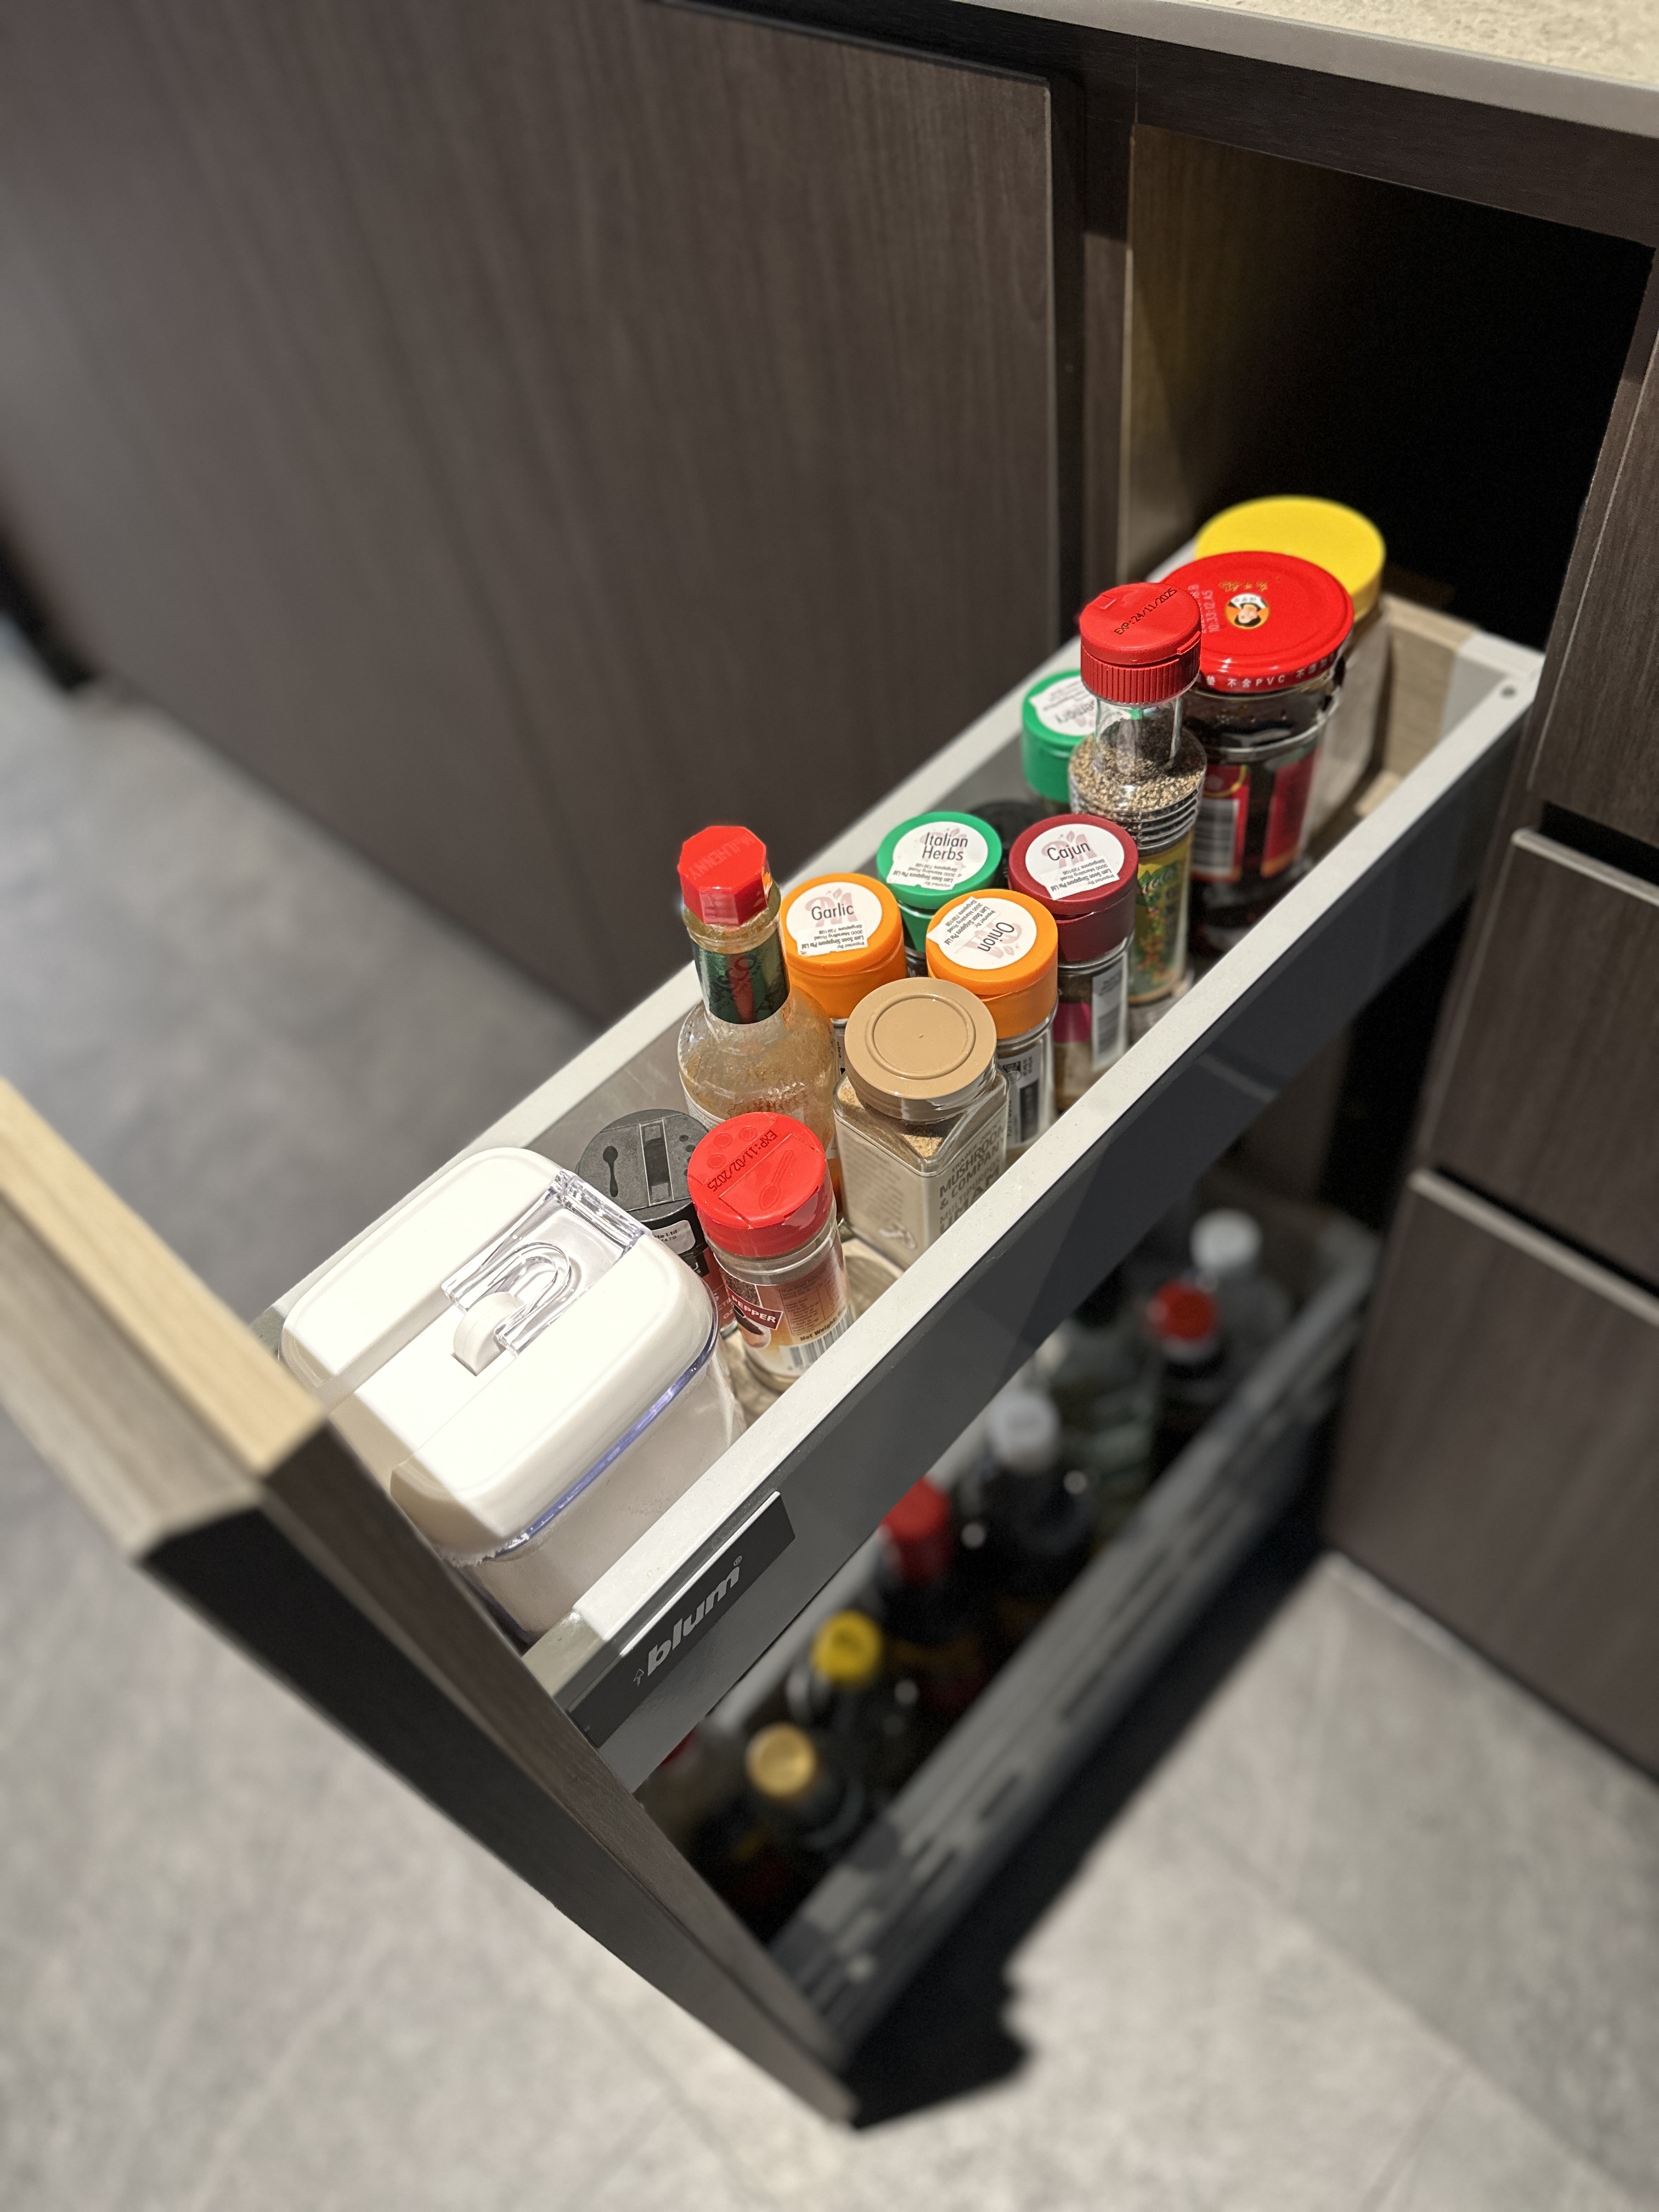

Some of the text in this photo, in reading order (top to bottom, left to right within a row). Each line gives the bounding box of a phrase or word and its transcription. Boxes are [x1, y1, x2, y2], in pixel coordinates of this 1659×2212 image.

[1113, 587, 1178, 635] EXP:24/11/2025
[924, 832, 968, 848] Italian
[922, 845, 964, 861] Herbs
[1047, 842, 1091, 861] Cajun
[1081, 859, 1105, 869] Singapore
[909, 872, 931, 881] Singapore
[1066, 876, 1088, 886] Singapore
[811, 902, 855, 921] Garlic
[818, 938, 841, 946] Singapore
[977, 922, 1014, 952] Onion
[707, 1130, 778, 1192] EXP:11/02/2025
[940, 1198, 949, 1210] &
[731, 1294, 776, 1323] PEPPER
[799, 1317, 837, 1342] Net Weight:
[647, 1566, 740, 1677] blum
